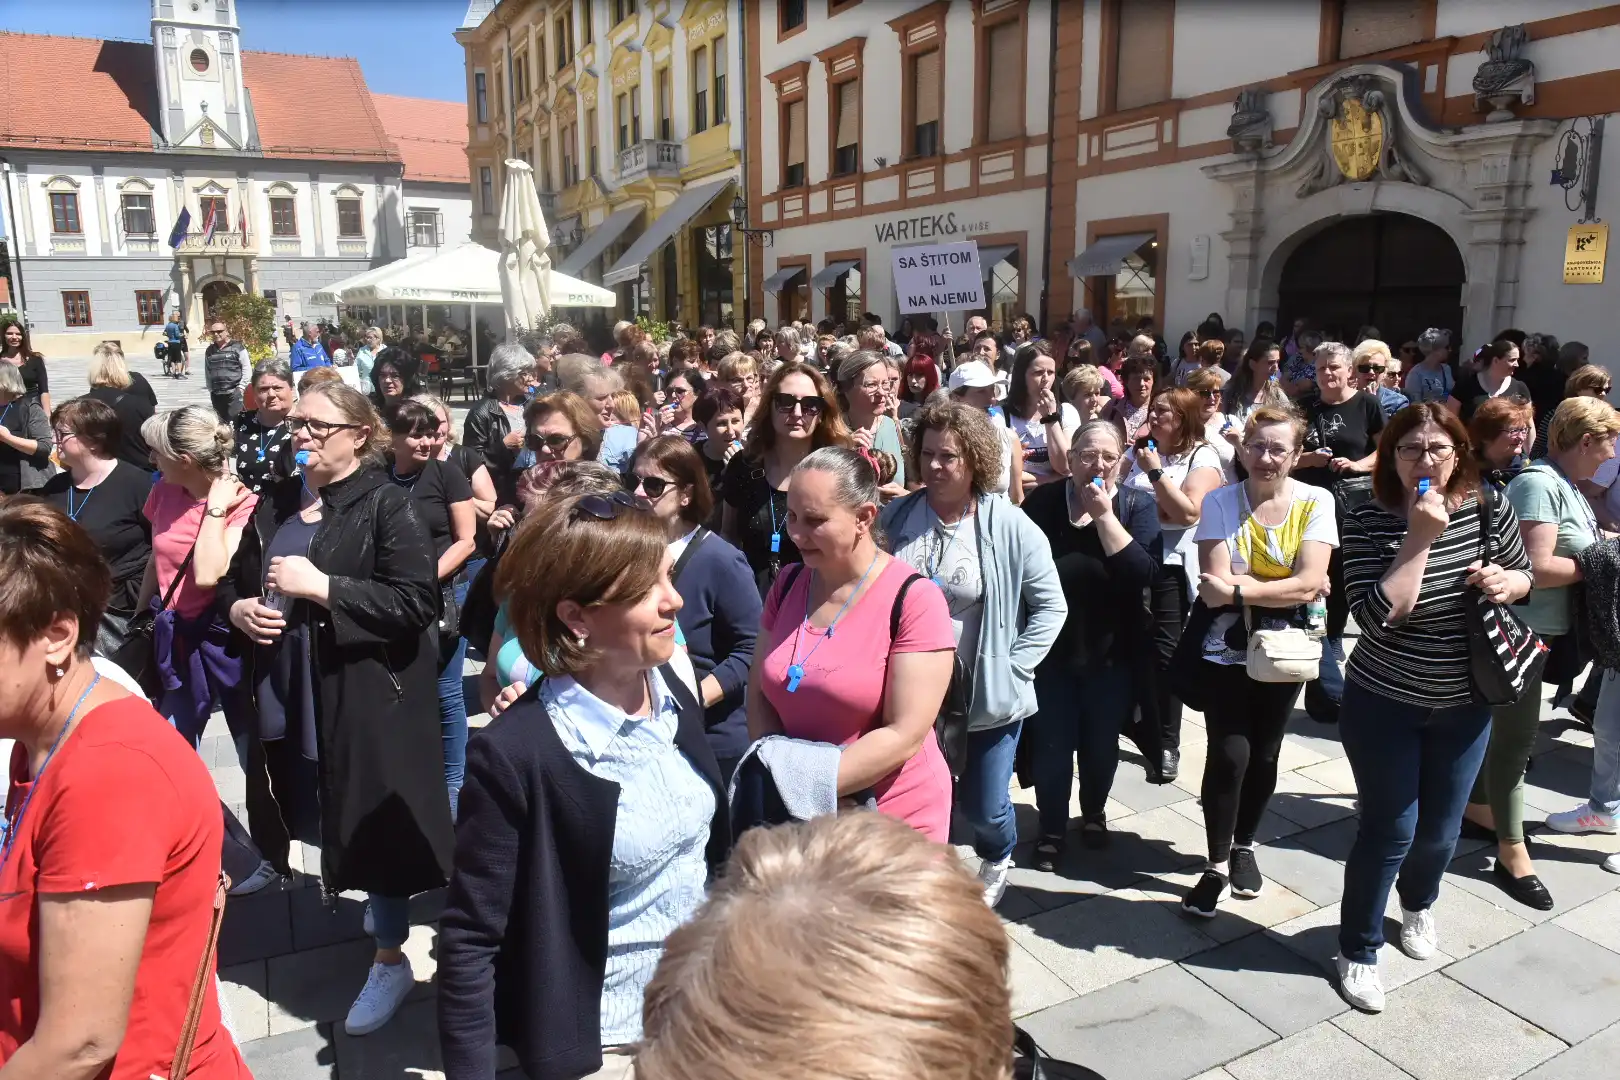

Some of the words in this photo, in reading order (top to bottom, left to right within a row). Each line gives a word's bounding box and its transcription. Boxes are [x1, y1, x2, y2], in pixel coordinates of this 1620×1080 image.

[899, 257, 917, 268] SA
[921, 252, 971, 267] ŠTITOM
[929, 274, 945, 286] ILI
[392, 287, 421, 297] PAN
[451, 290, 479, 300] PAN
[568, 293, 593, 303] PAN
[908, 296, 927, 307] NA
[931, 292, 977, 305] NJEMU
